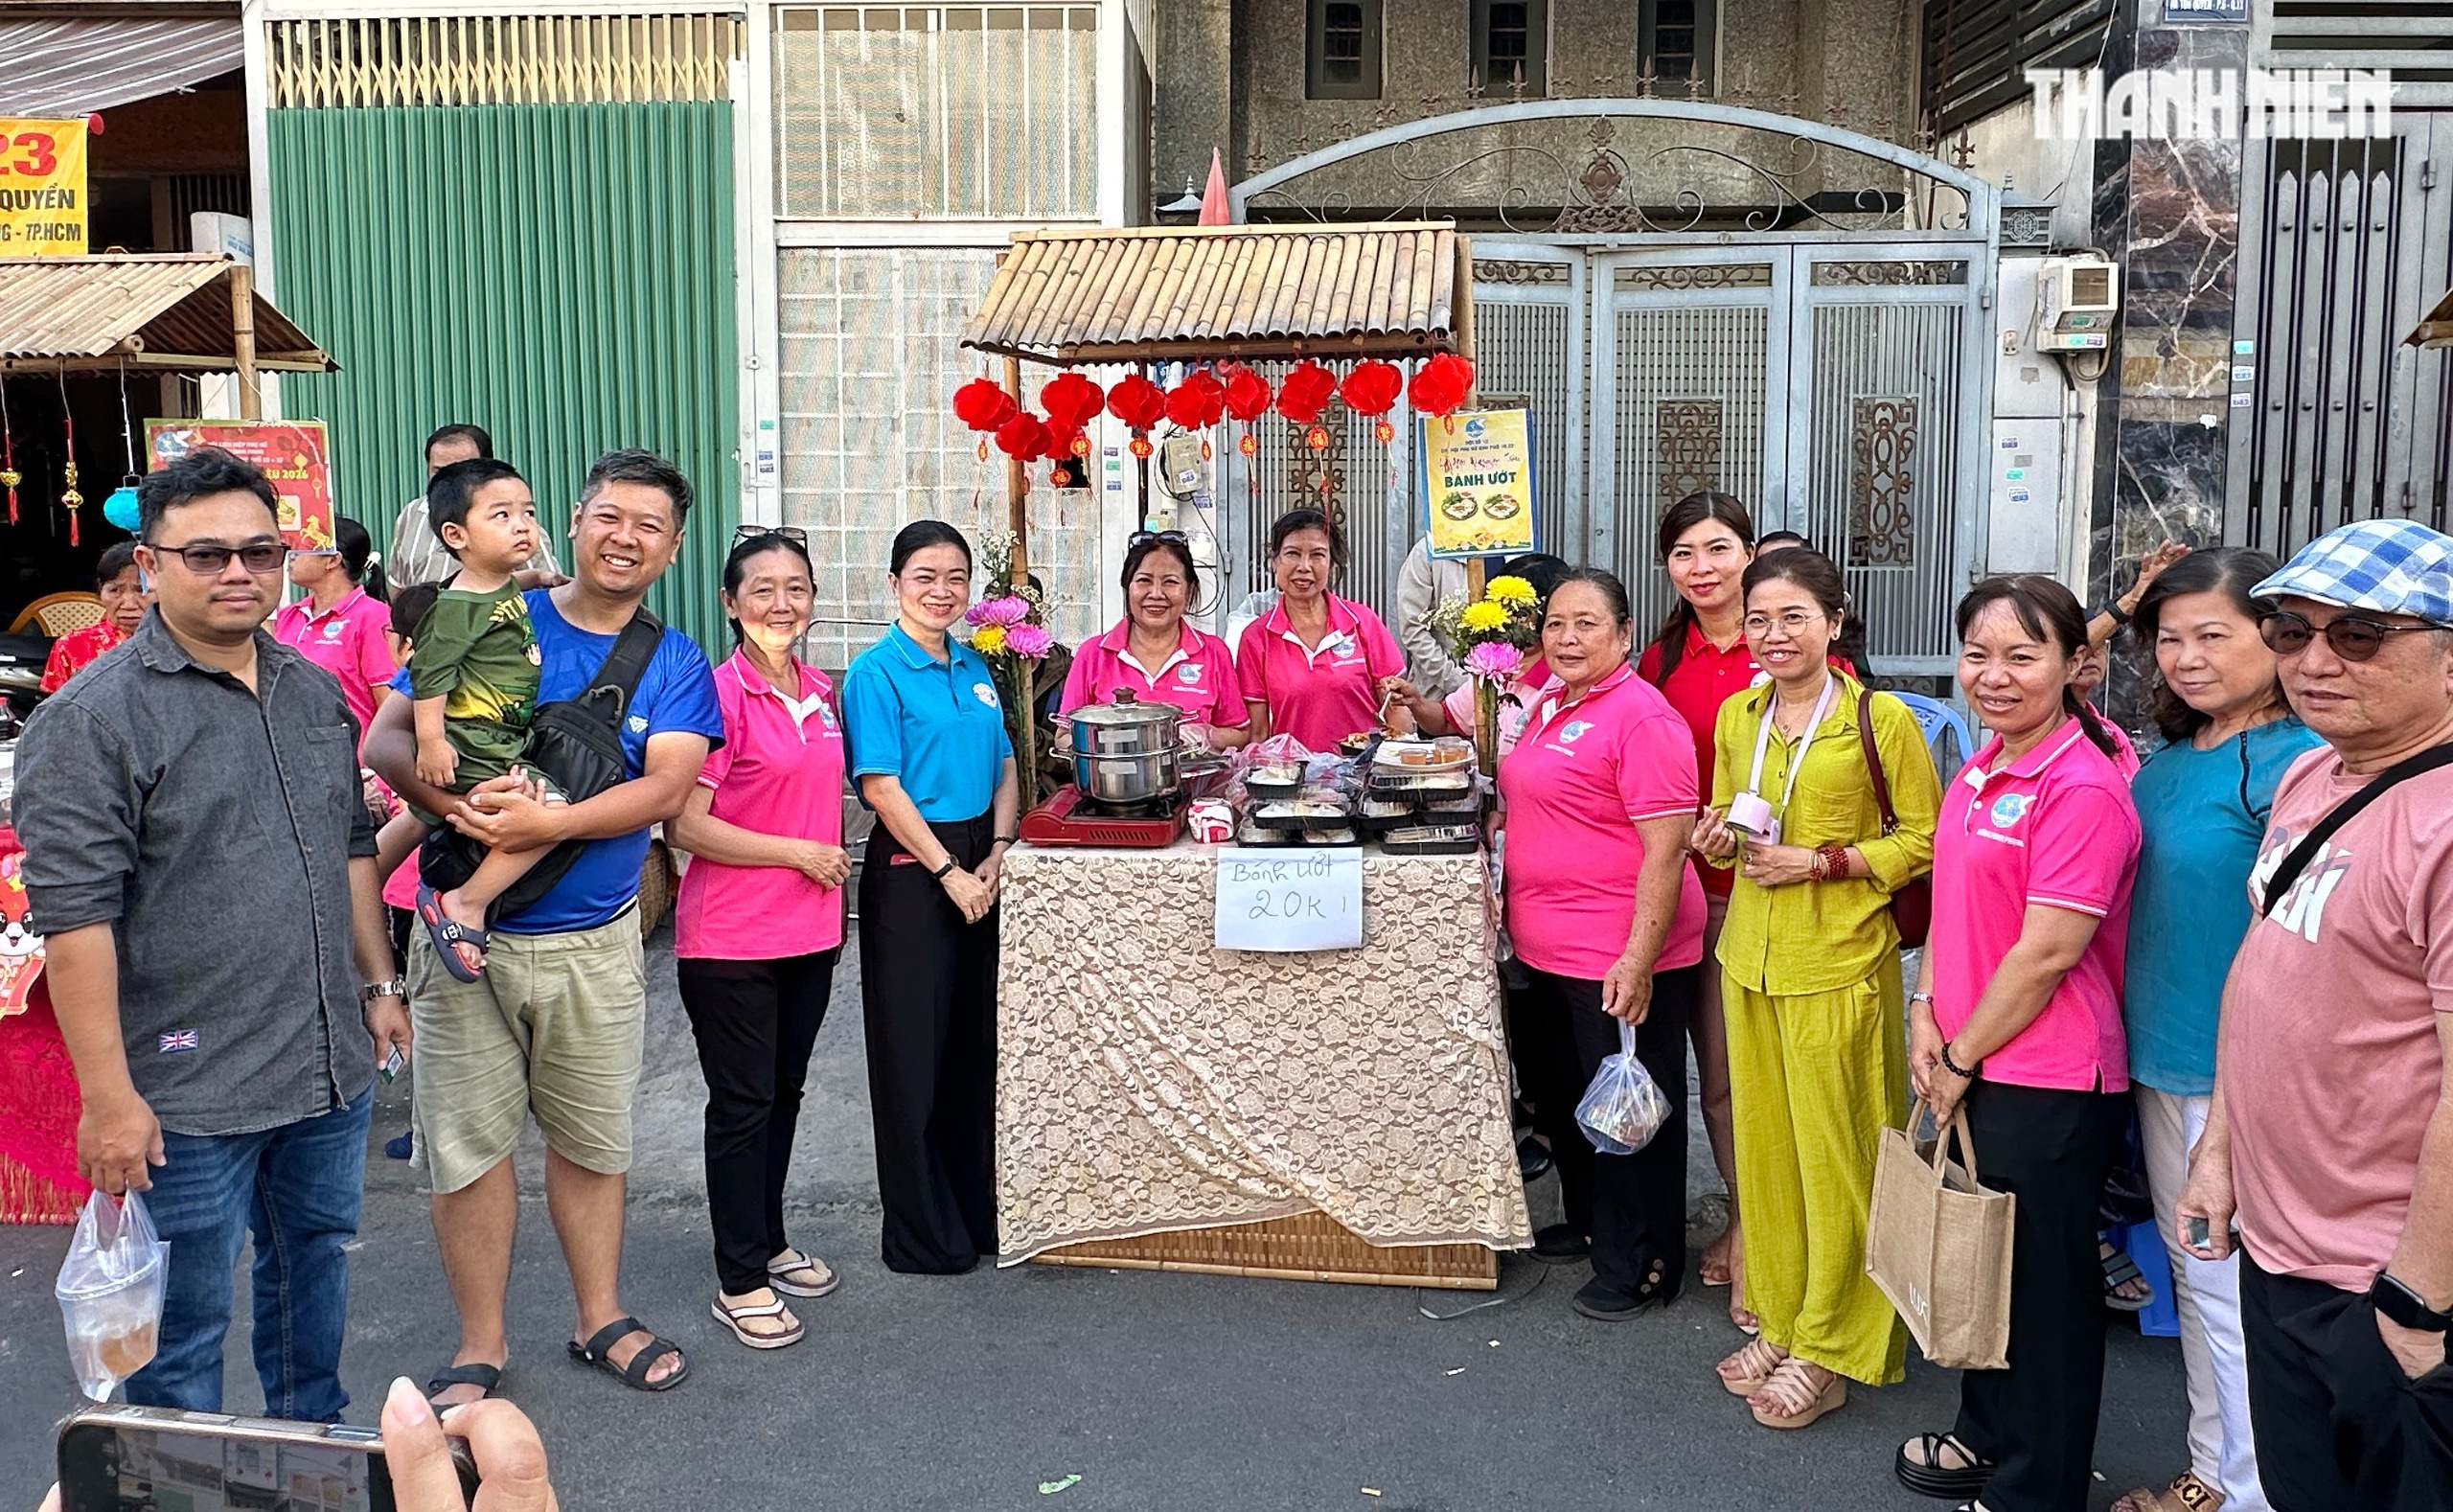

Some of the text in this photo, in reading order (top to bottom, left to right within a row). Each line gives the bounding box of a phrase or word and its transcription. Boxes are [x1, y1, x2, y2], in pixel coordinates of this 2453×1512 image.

[0, 132, 57, 176] 3
[0, 223, 11, 241] G
[26, 222, 81, 241] TP.HCM
[1444, 473, 1484, 488] BÁNH
[2172, 1473, 2212, 1511] CCI
